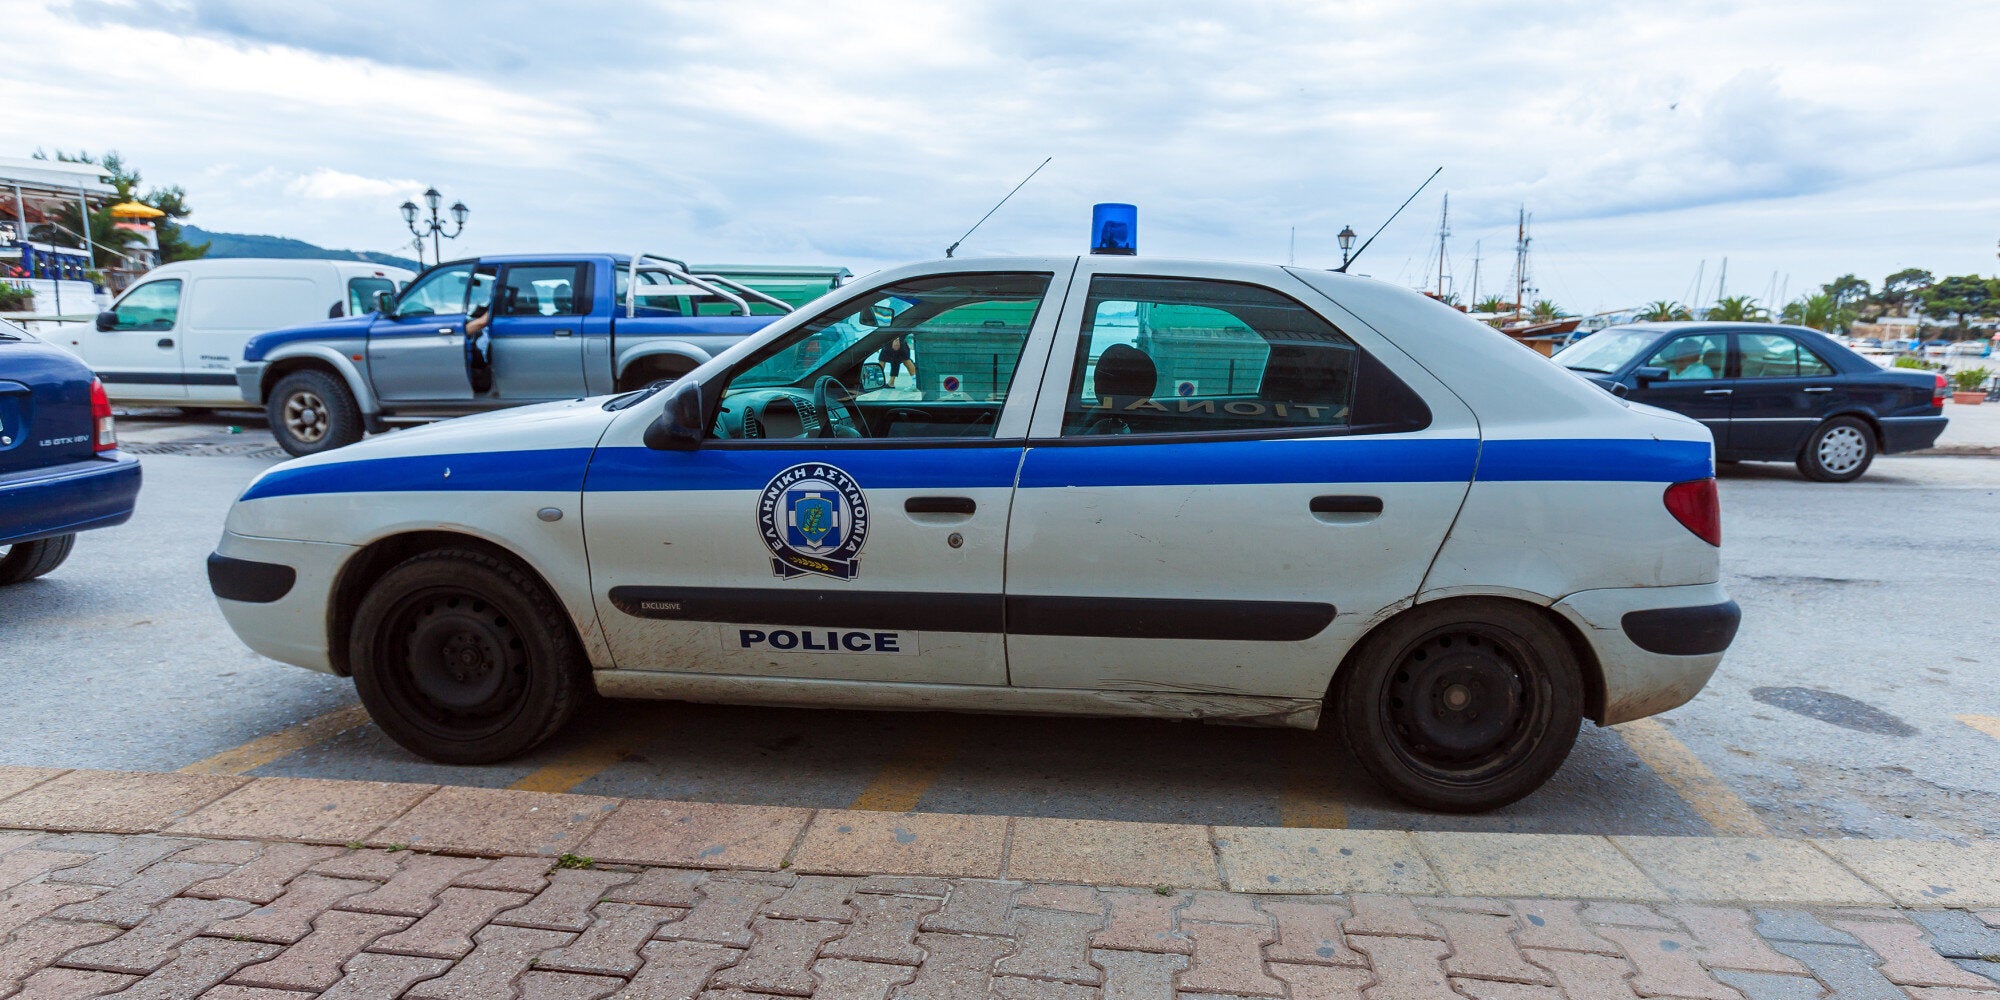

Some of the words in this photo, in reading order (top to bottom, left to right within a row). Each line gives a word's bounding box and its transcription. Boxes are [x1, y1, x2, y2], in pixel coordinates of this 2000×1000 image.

[762, 467, 807, 551] ΕΛΛΗΝΙΚΗ
[813, 467, 866, 552] ΑΣΤΥΝΟΜΙΑ
[641, 602, 681, 610] EXCLUSIVE
[739, 629, 900, 652] POLICE
